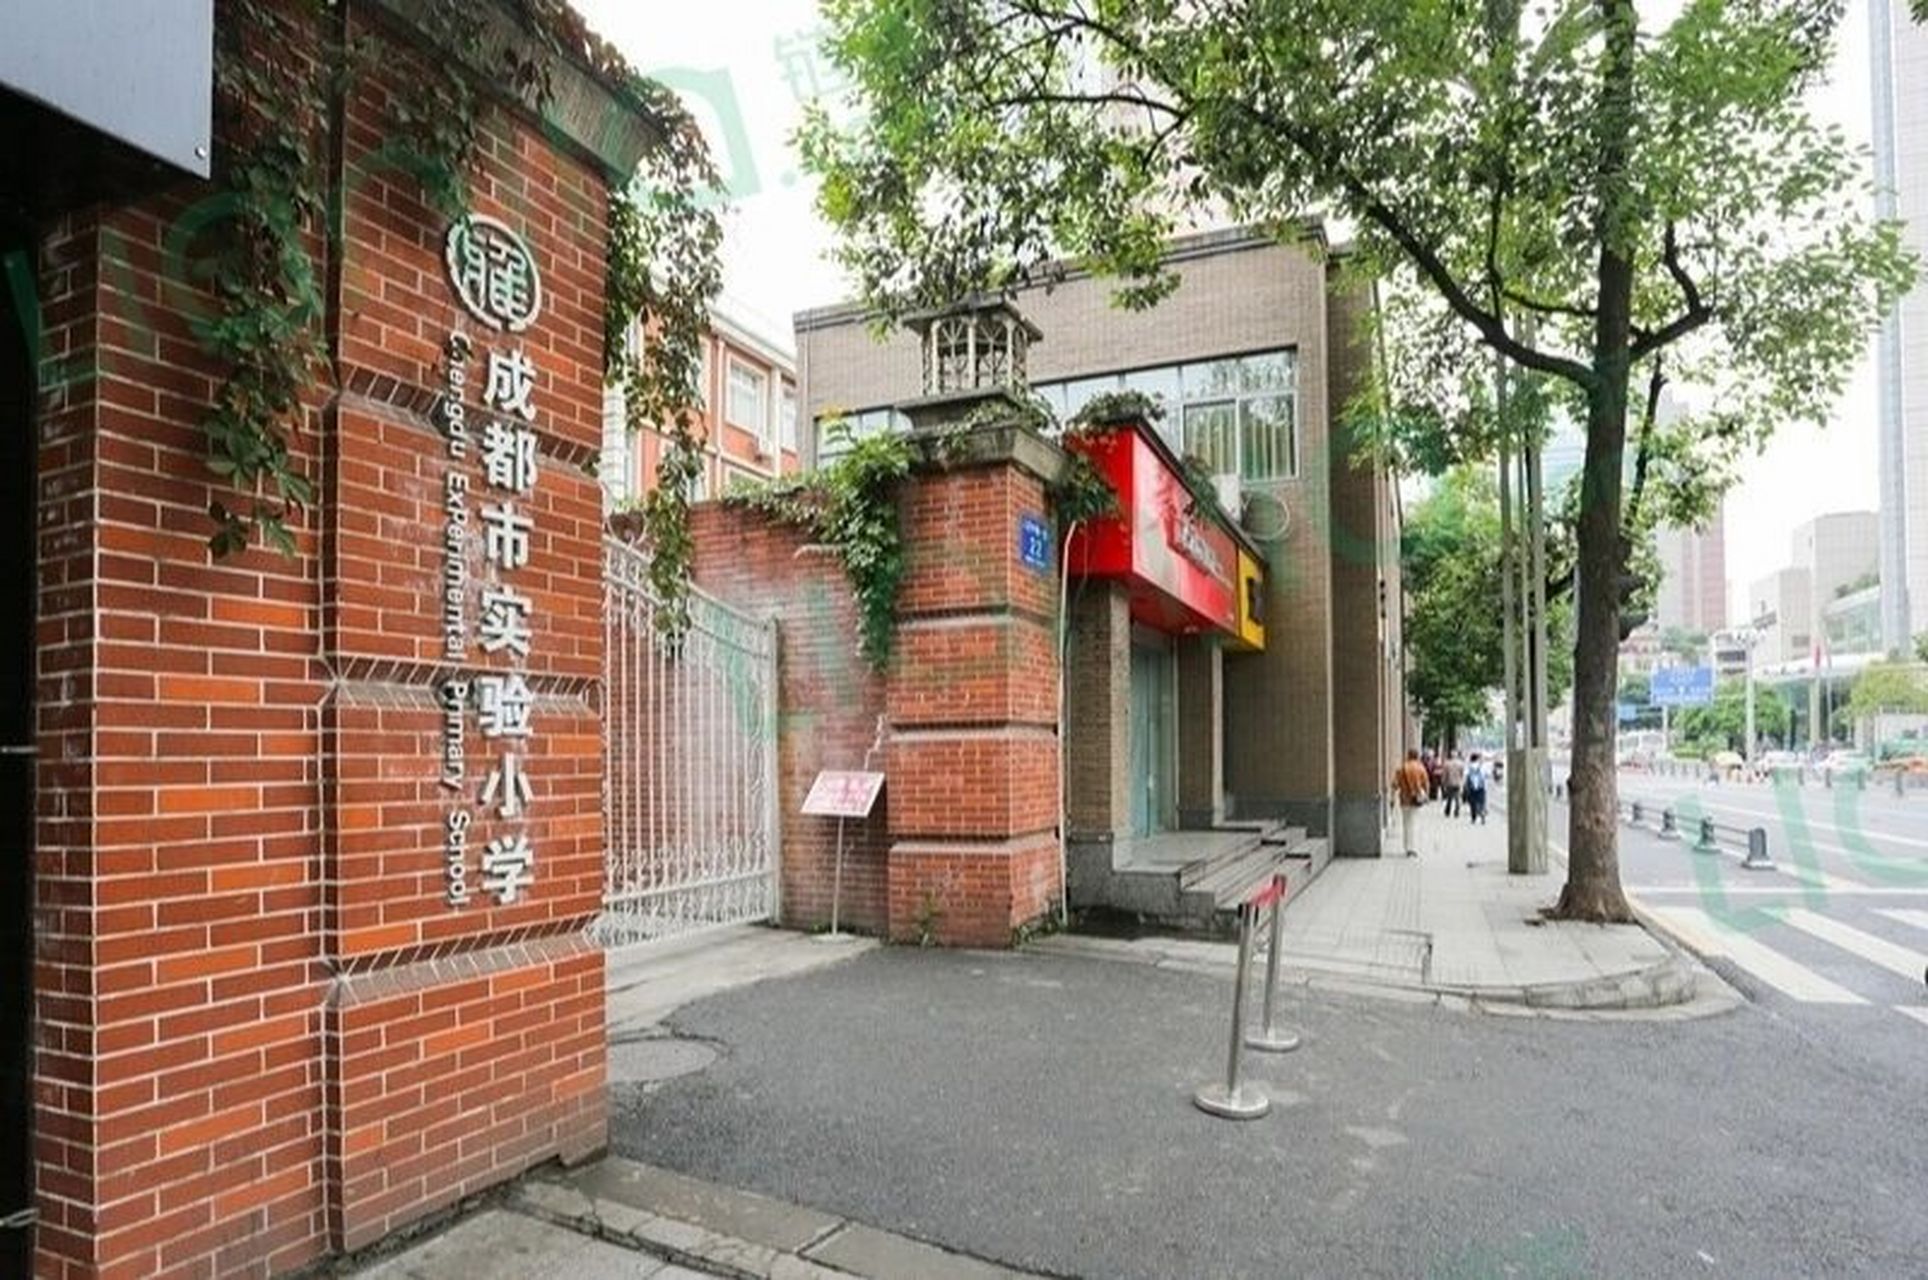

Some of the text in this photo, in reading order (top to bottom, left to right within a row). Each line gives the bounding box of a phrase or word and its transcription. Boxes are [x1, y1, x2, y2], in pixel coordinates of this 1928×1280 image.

[481, 349, 537, 904] 成都市实验小学
[443, 680, 469, 790] Primary
[448, 810, 471, 905] School
